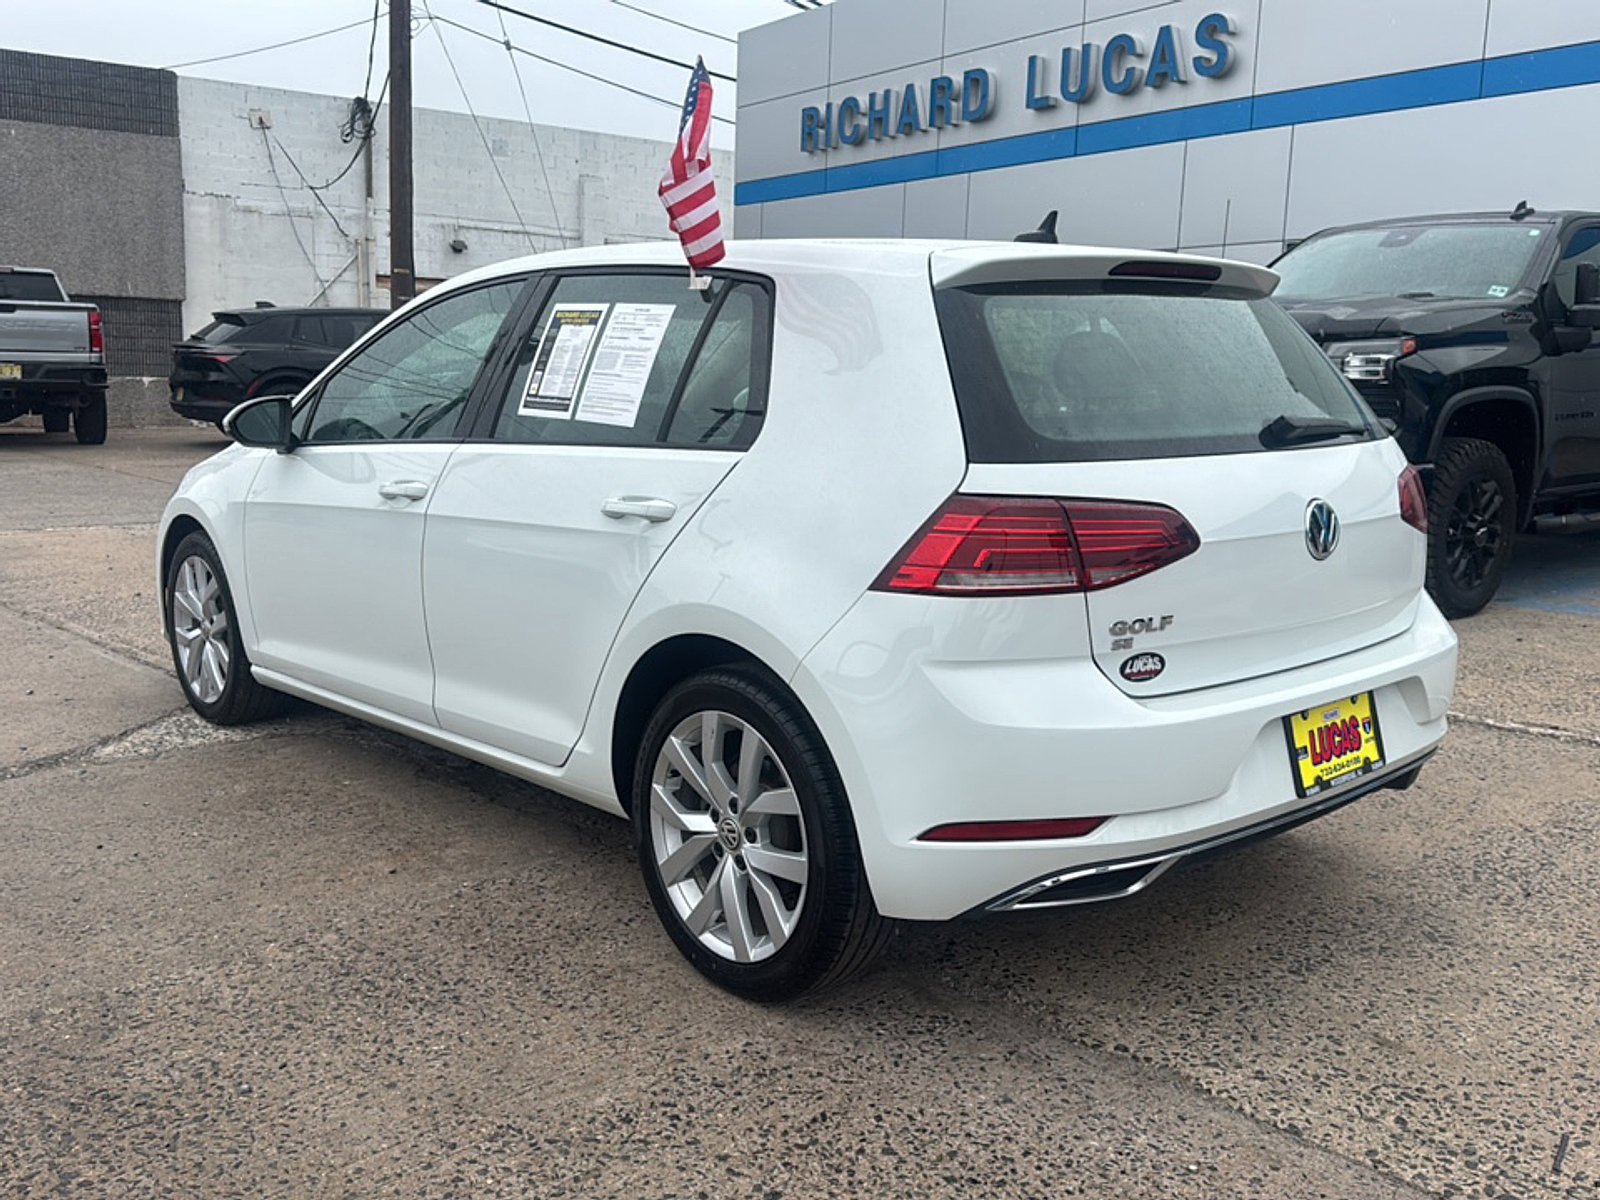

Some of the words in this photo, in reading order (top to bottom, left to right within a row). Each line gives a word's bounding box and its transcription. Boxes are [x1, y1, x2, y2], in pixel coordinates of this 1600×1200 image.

[800, 67, 995, 153] RICHARD
[1026, 13, 1236, 110] LUCAS
[1109, 615, 1174, 636] GOLF
[1125, 656, 1162, 674] LUCAS
[1309, 715, 1362, 766] LUCAS
